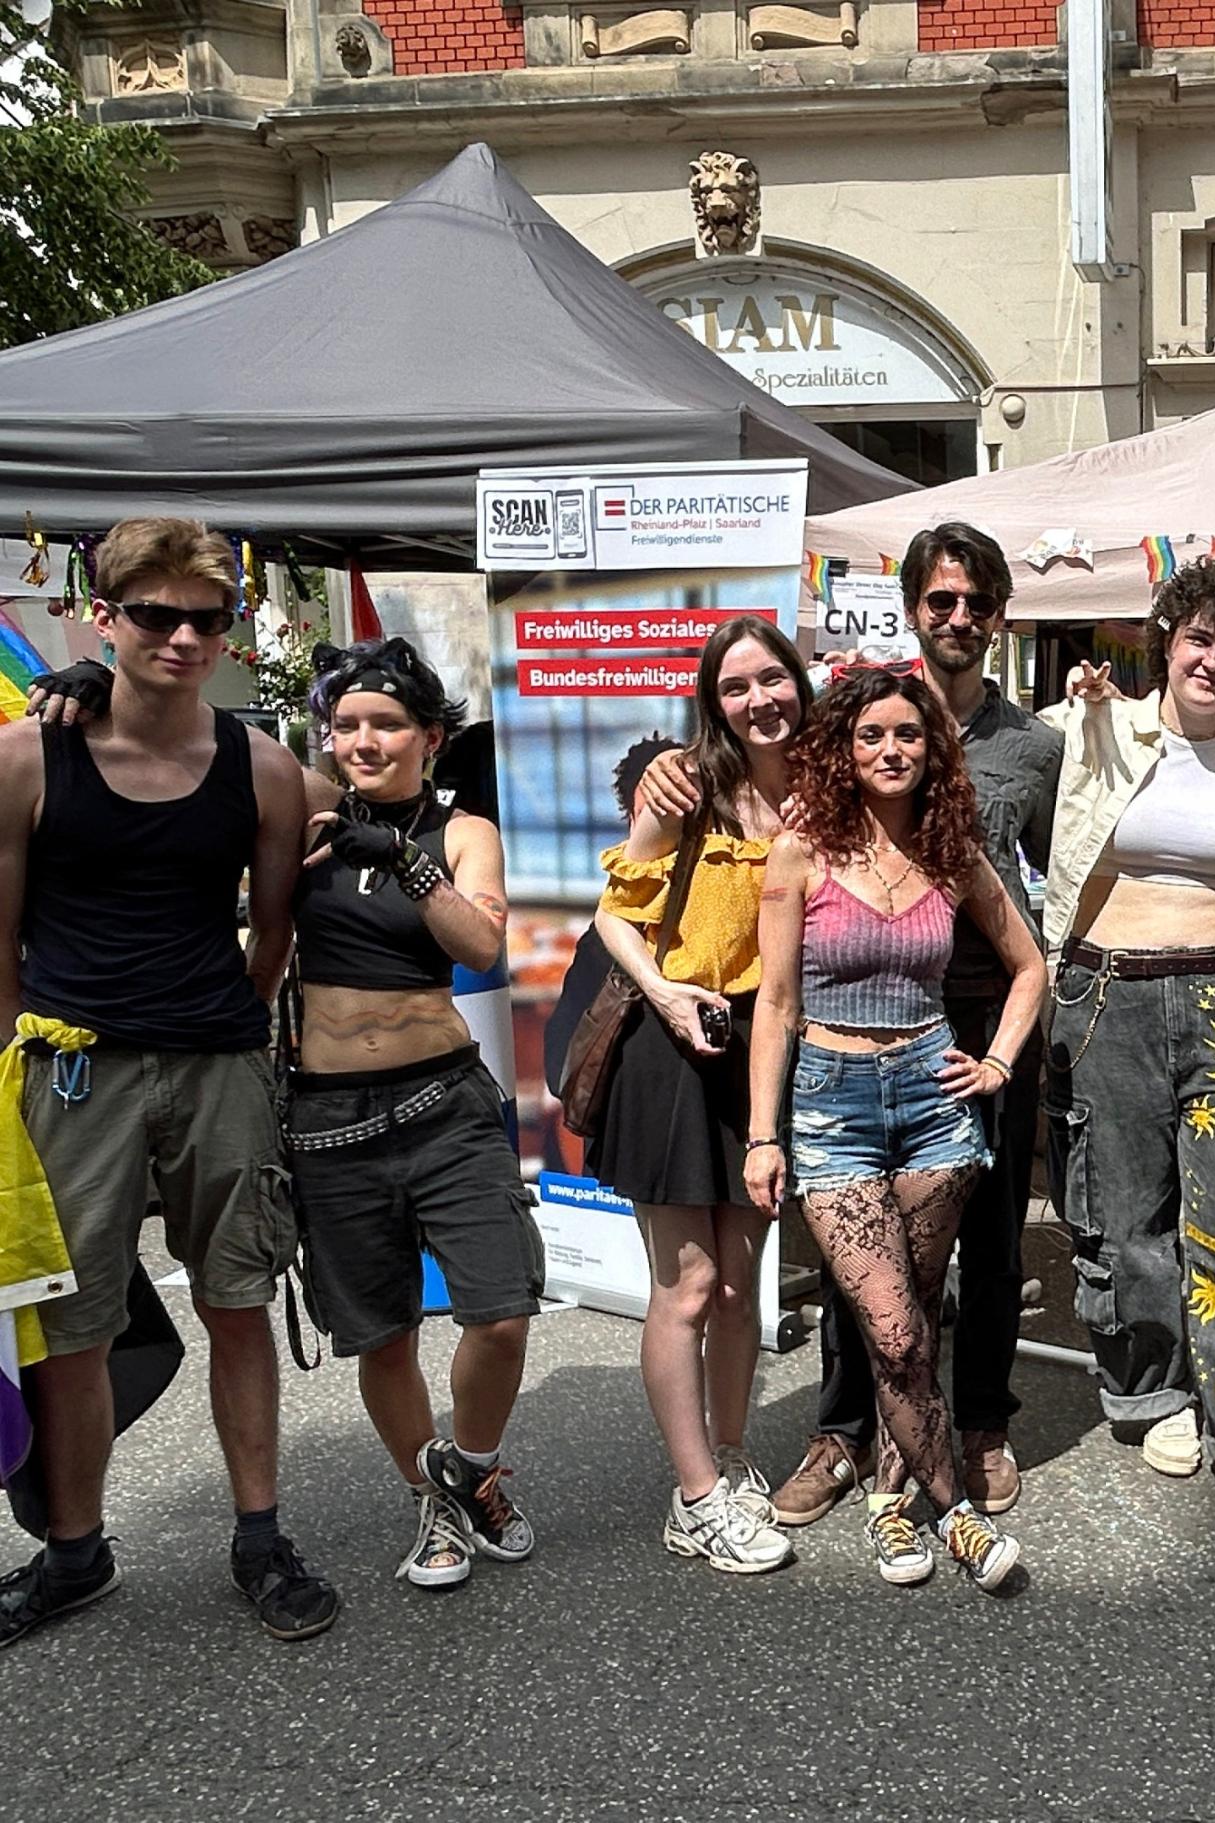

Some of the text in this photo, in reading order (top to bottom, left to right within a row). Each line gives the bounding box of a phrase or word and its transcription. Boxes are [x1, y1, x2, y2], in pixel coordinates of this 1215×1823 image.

[656, 294, 842, 353] SIAM
[752, 366, 888, 394] Spezialitäten
[492, 499, 547, 525] SCAN
[630, 494, 790, 516] DER PARITÄTISCHE
[497, 518, 545, 536] Here
[631, 518, 761, 531] Rheinland-Pfalz Saarland
[631, 534, 723, 547] Freiwilligendienste
[524, 617, 717, 643] Freiwilliges Soziales
[825, 609, 899, 638] CN-3
